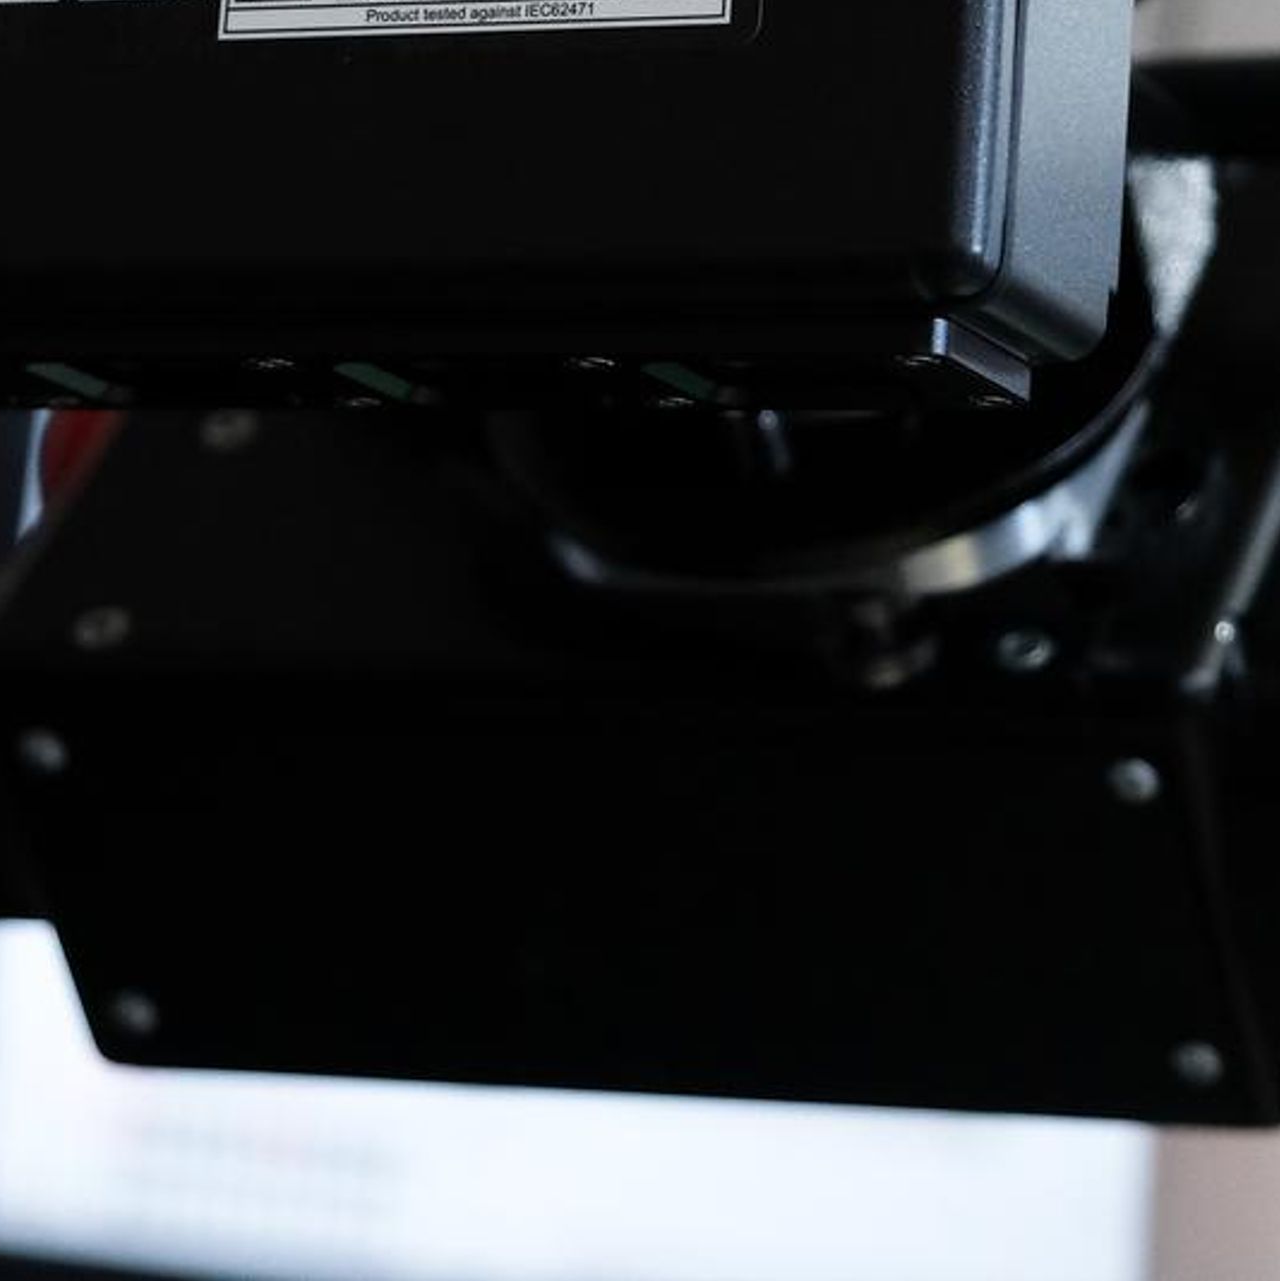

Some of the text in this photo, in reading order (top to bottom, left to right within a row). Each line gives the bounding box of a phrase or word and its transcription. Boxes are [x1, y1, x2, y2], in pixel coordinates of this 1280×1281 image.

[366, 1, 595, 23] Product tested against IEC62471
